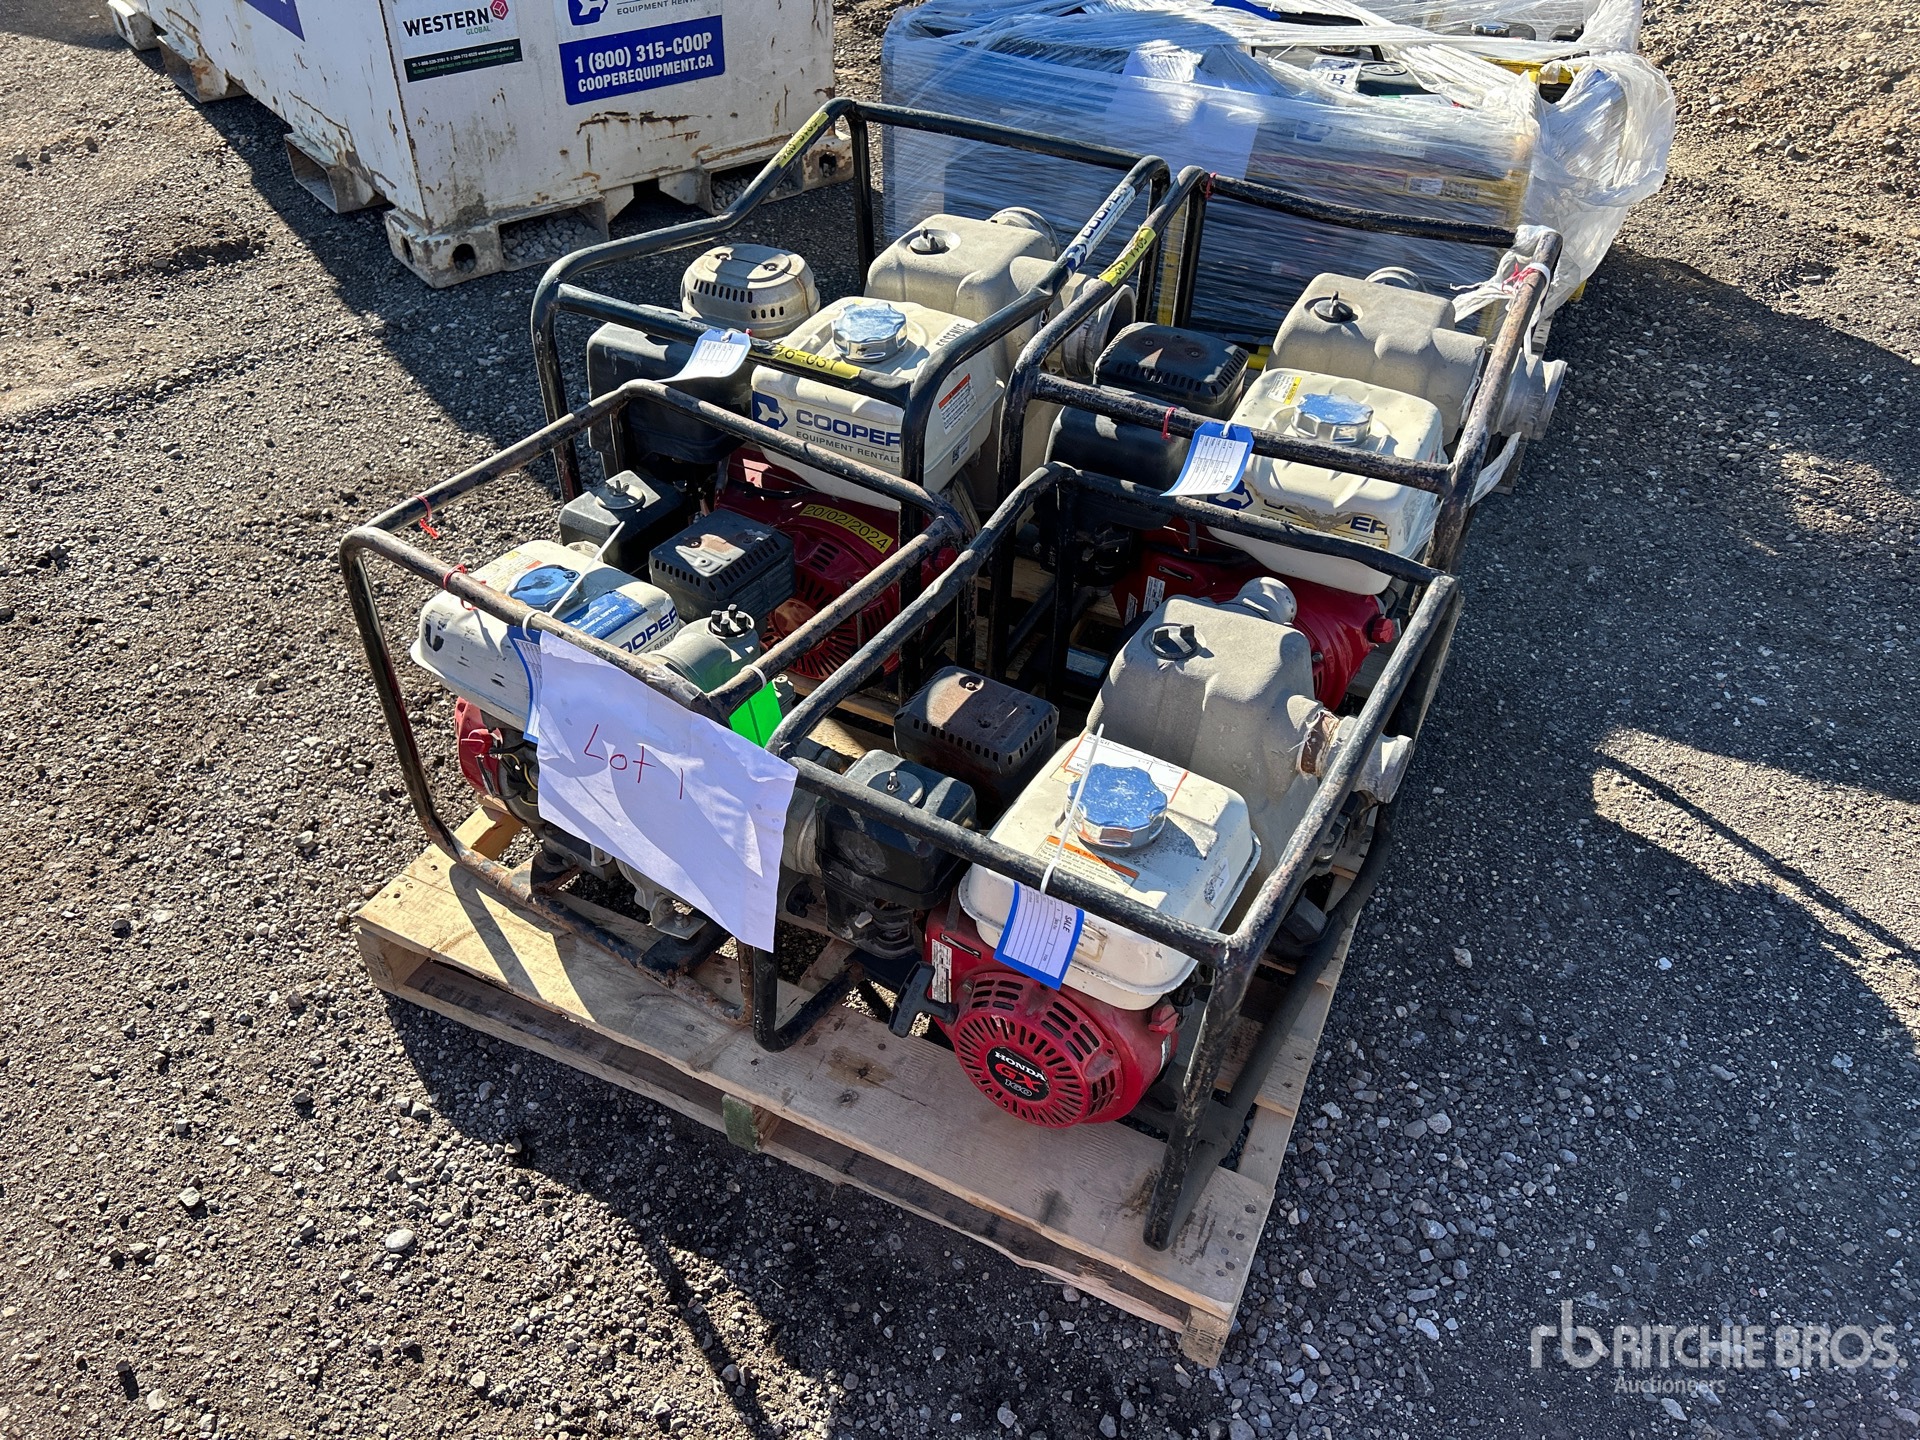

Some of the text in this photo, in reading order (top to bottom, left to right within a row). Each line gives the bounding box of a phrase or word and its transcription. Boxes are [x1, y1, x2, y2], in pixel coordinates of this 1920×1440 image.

[403, 8, 489, 37] WESTERN
[617, 1, 669, 15] EQUIPMENT
[466, 26, 491, 35] GLOBAL
[575, 32, 712, 74] 1 (800) 315-COOP
[578, 54, 714, 92] COOPEREQUIPMENT.CA
[796, 409, 901, 446] COOPER
[796, 430, 854, 452] EQUIPMENT
[803, 506, 888, 549] 20/02/2024
[1063, 915, 1072, 933] SALE
[994, 1051, 1048, 1081] HONDA
[996, 1064, 1042, 1092] GX
